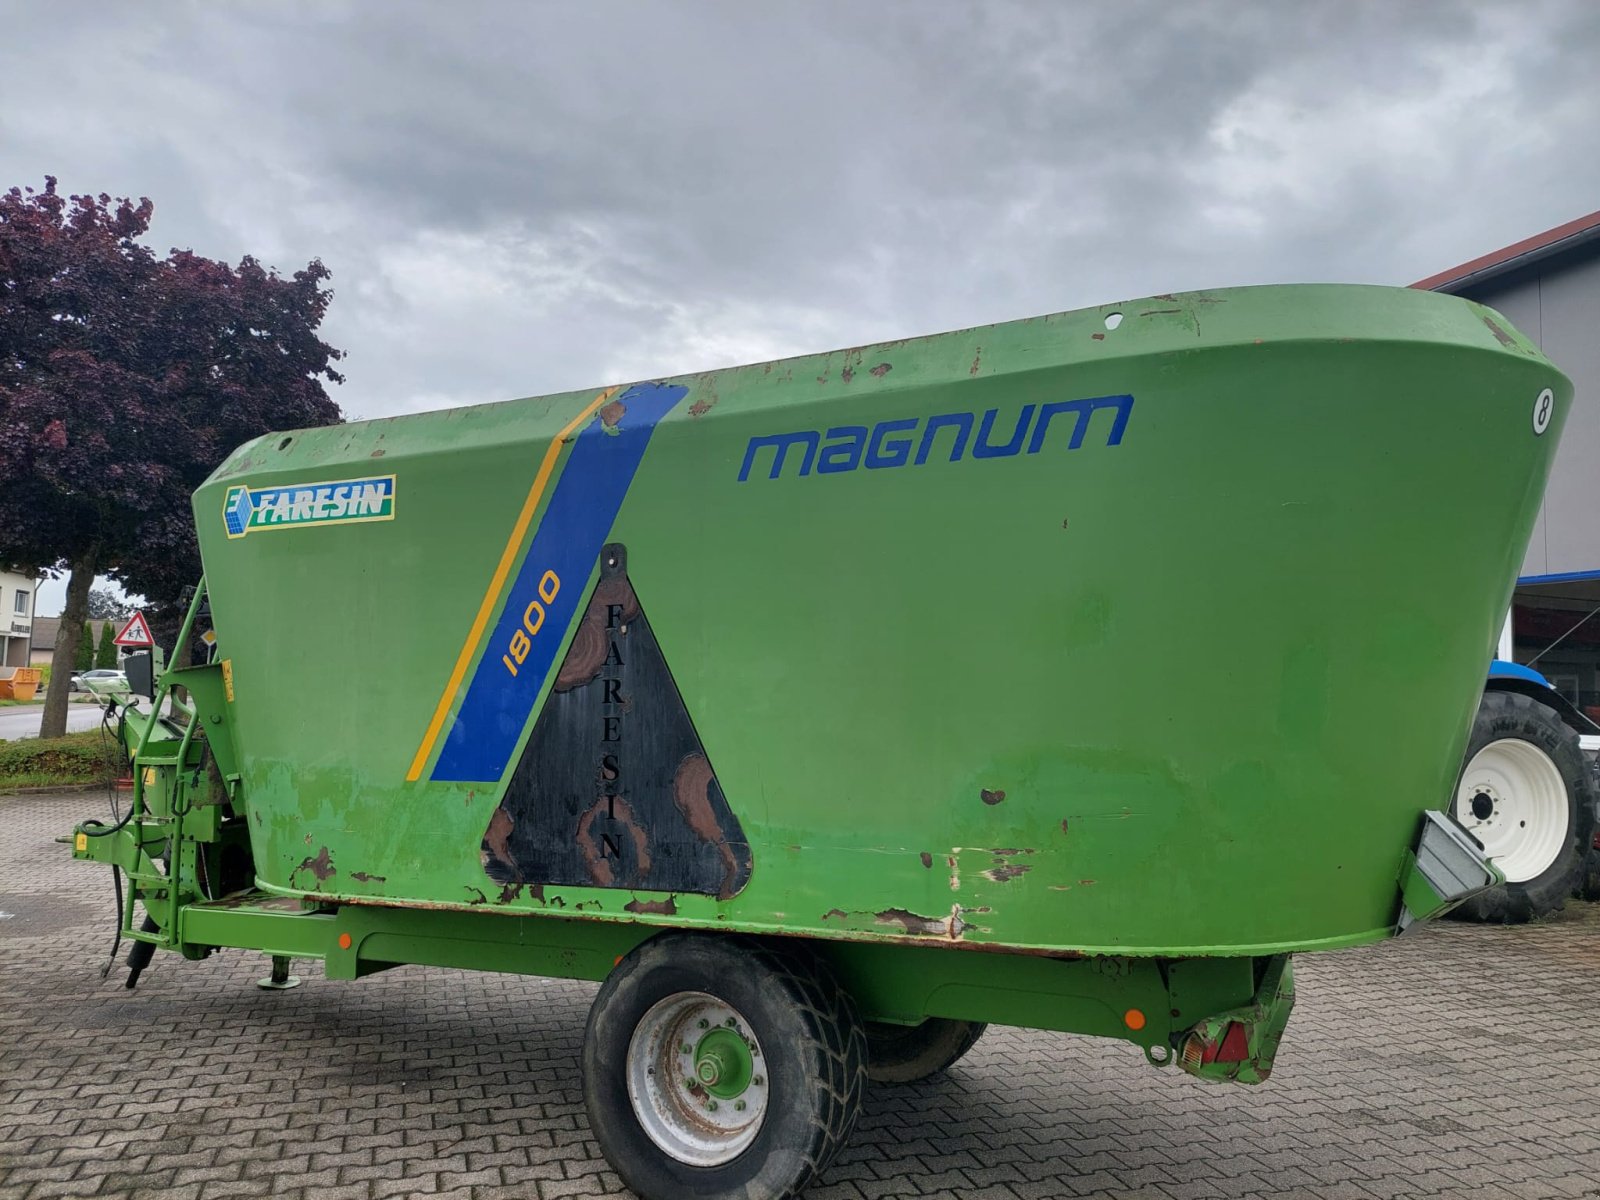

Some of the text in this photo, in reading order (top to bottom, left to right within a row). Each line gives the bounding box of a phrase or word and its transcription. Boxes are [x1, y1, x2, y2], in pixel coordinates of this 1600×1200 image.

[1538, 394, 1550, 426] 8
[256, 482, 386, 524] FARESIN
[502, 569, 561, 677] 1800
[599, 603, 626, 860] FARESIN
